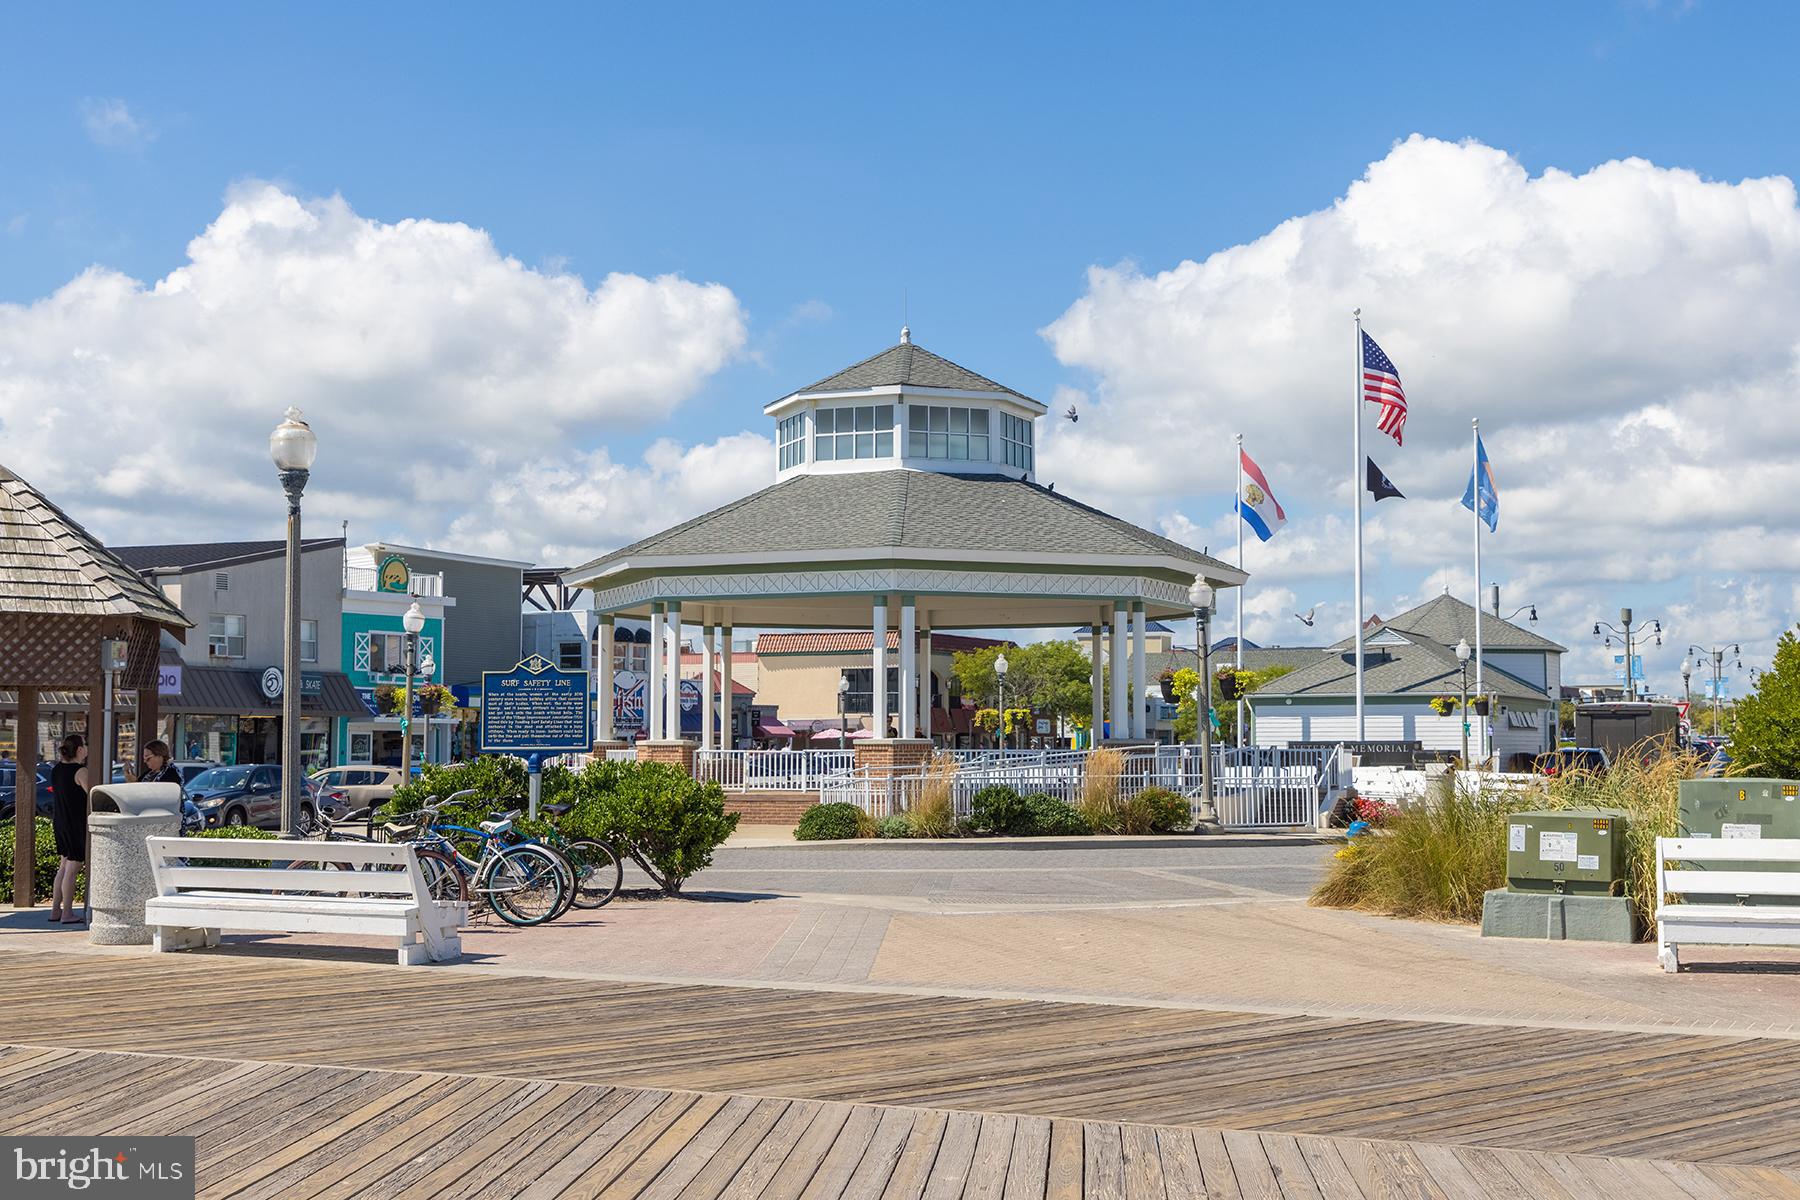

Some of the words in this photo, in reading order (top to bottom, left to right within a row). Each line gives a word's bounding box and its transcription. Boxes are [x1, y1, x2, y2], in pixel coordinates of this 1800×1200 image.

[305, 679, 321, 690] SKATE
[501, 679, 520, 687] SURF
[523, 679, 551, 687] SAFETY
[555, 679, 571, 687] LINE
[1350, 744, 1409, 753] MEMORIAL
[1554, 862, 1565, 872] 50
